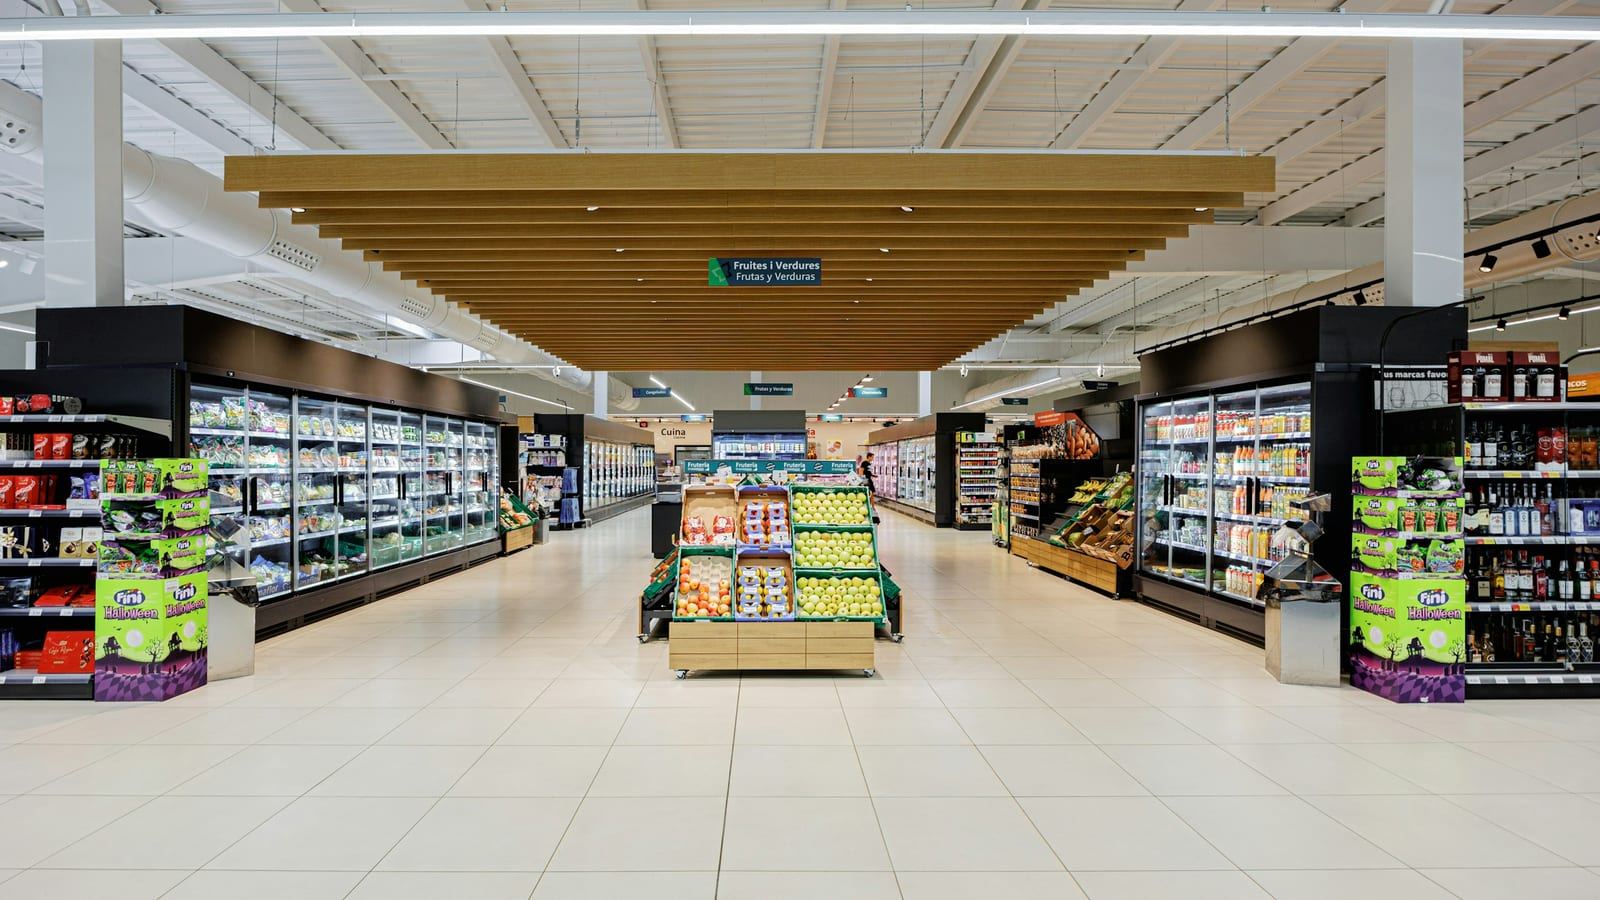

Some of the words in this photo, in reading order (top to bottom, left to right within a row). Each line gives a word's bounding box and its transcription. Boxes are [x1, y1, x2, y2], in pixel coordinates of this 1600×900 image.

[734, 261, 767, 270] Fruites
[770, 261, 773, 270] i
[776, 261, 820, 270] Verdures
[736, 272, 764, 280] Frutas
[767, 274, 772, 283] y
[775, 272, 815, 280] Verduras
[104, 606, 158, 620] Halloween
[165, 599, 206, 618] Halloween
[1354, 596, 1396, 619] Halloween
[1407, 606, 1462, 620] Halloween
